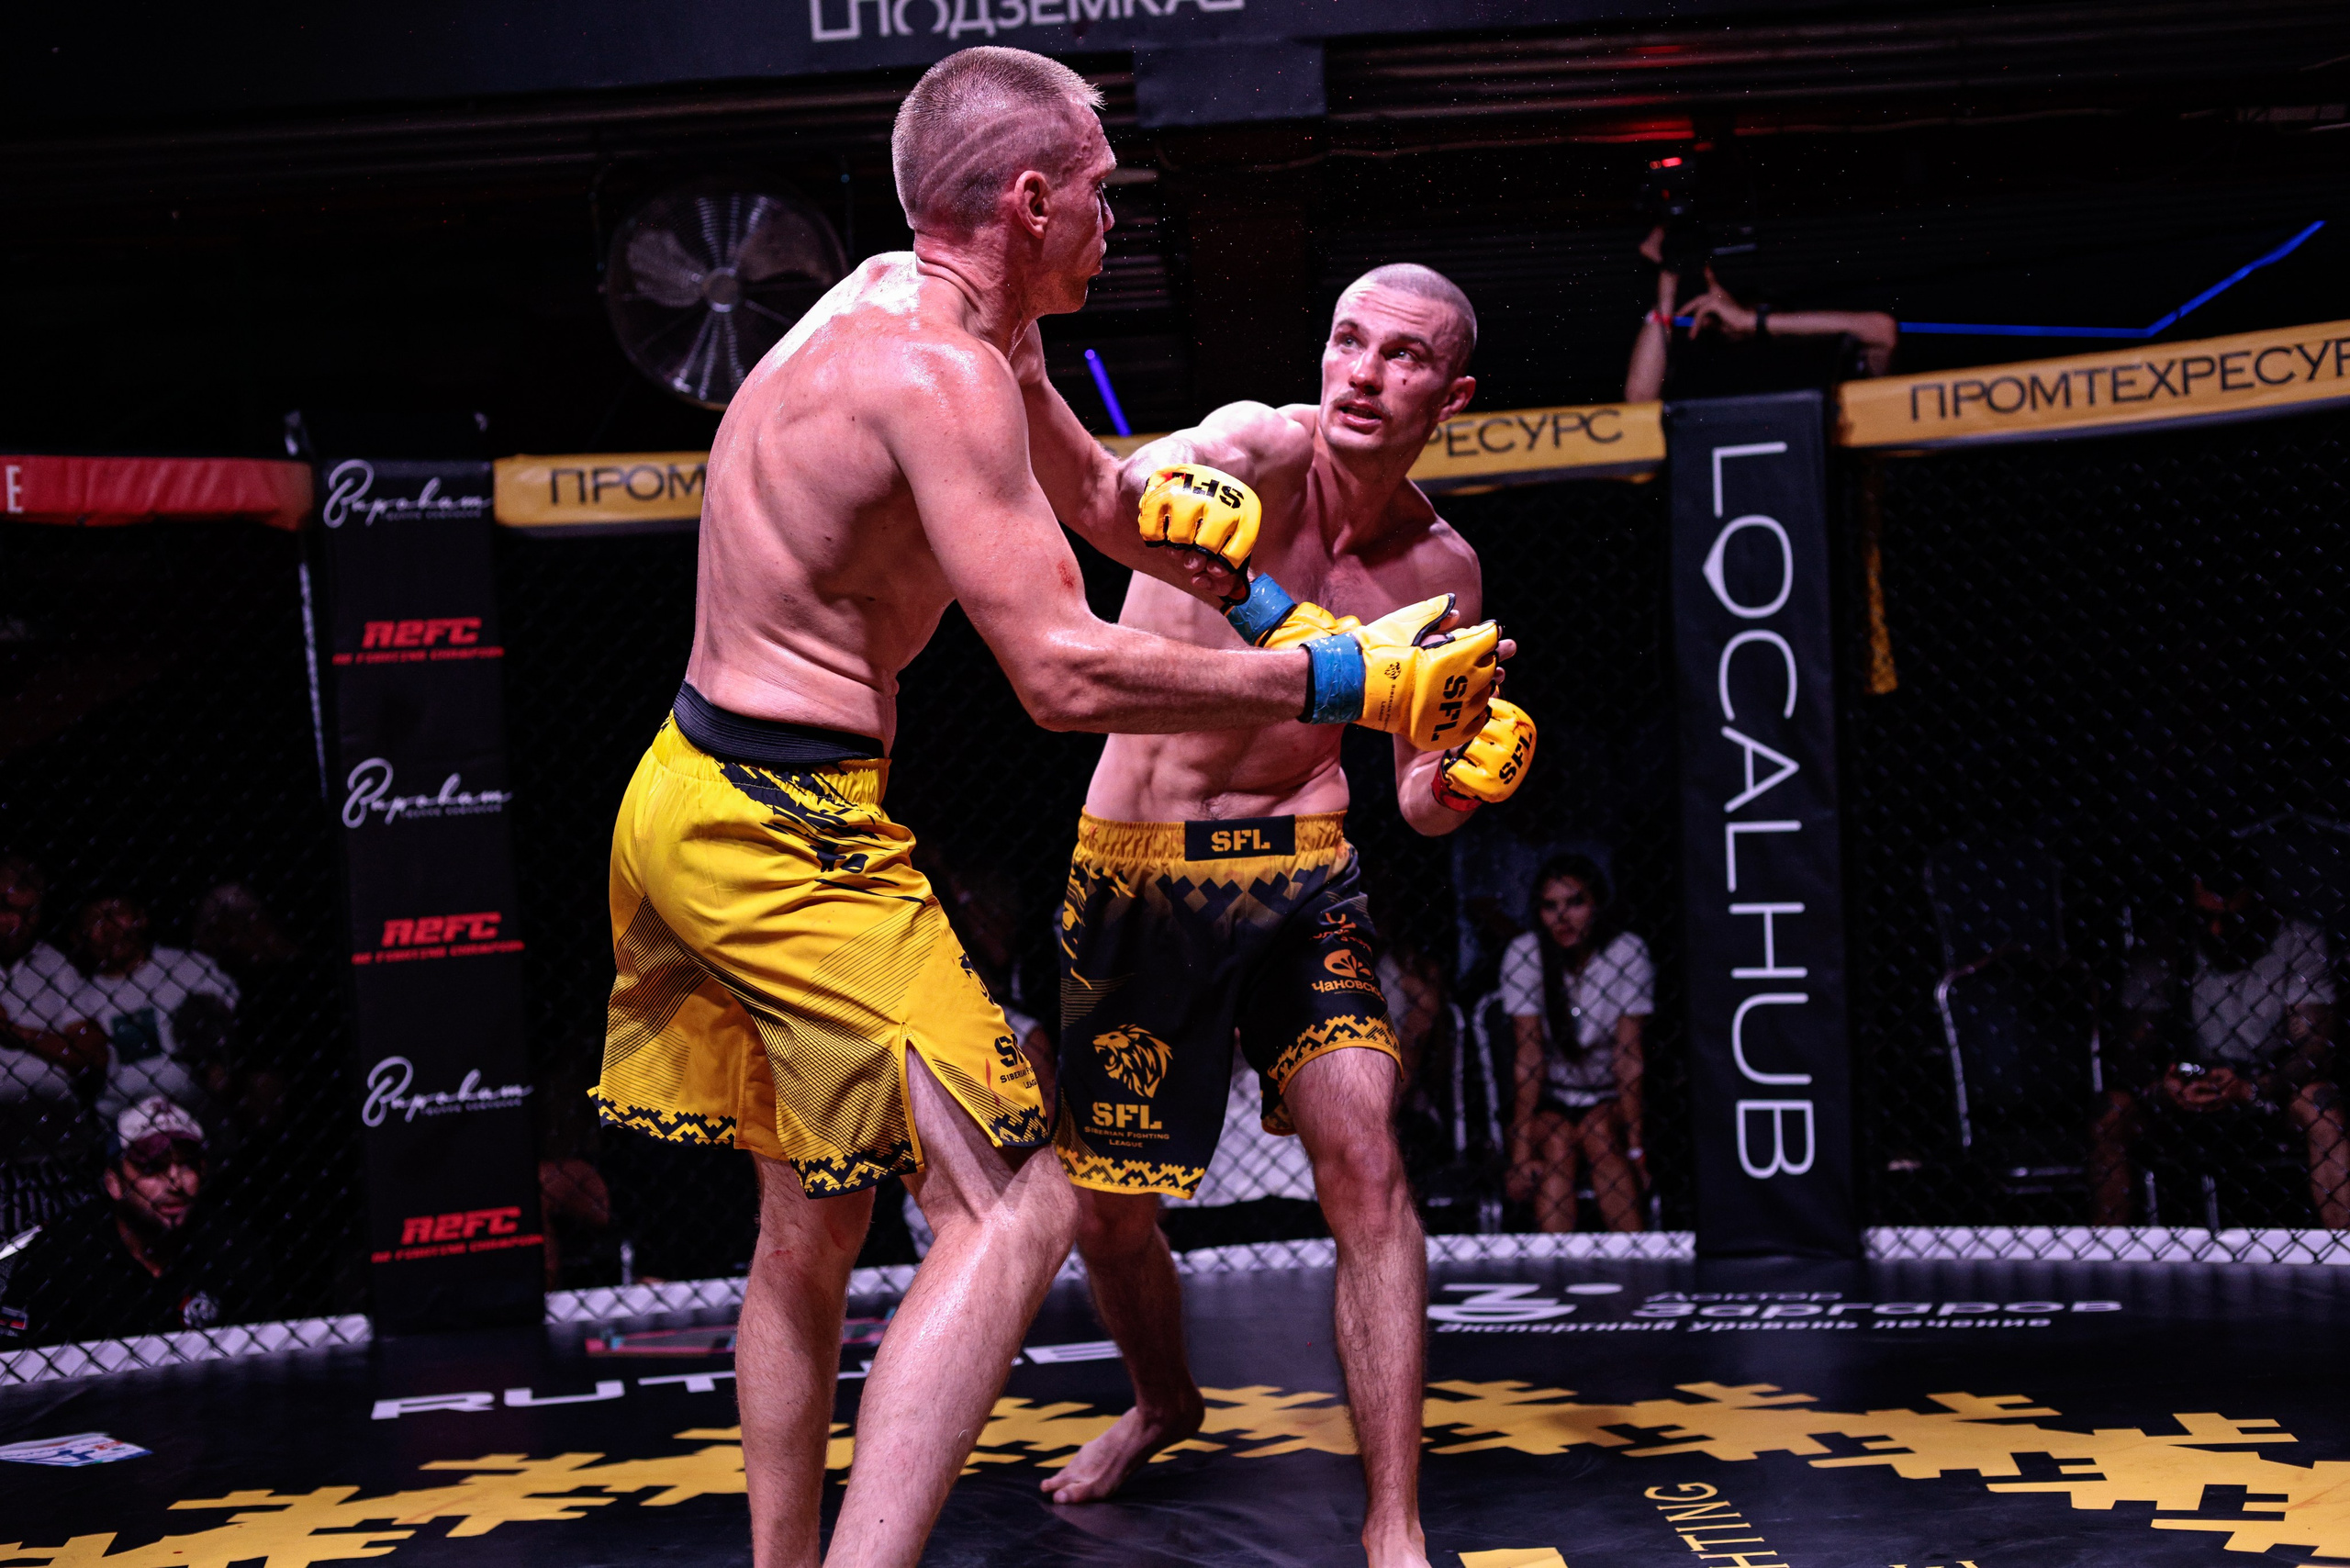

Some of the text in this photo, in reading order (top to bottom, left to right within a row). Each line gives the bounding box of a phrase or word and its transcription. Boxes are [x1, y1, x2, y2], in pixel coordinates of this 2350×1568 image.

[1172, 472, 1245, 509] SFL
[1431, 675, 1469, 743] SFL
[1499, 733, 1533, 785] SFL
[1702, 441, 1816, 1181] LOCALHUB
[1211, 828, 1271, 852] SFL
[1091, 1101, 1163, 1130] SFL
[1083, 1126, 1170, 1140] SIBERIAN FIGHTING
[1108, 1138, 1144, 1148] LEAGUE
[1631, 1300, 2123, 1319] Заргаров
[370, 1340, 1125, 1421] RUTE
